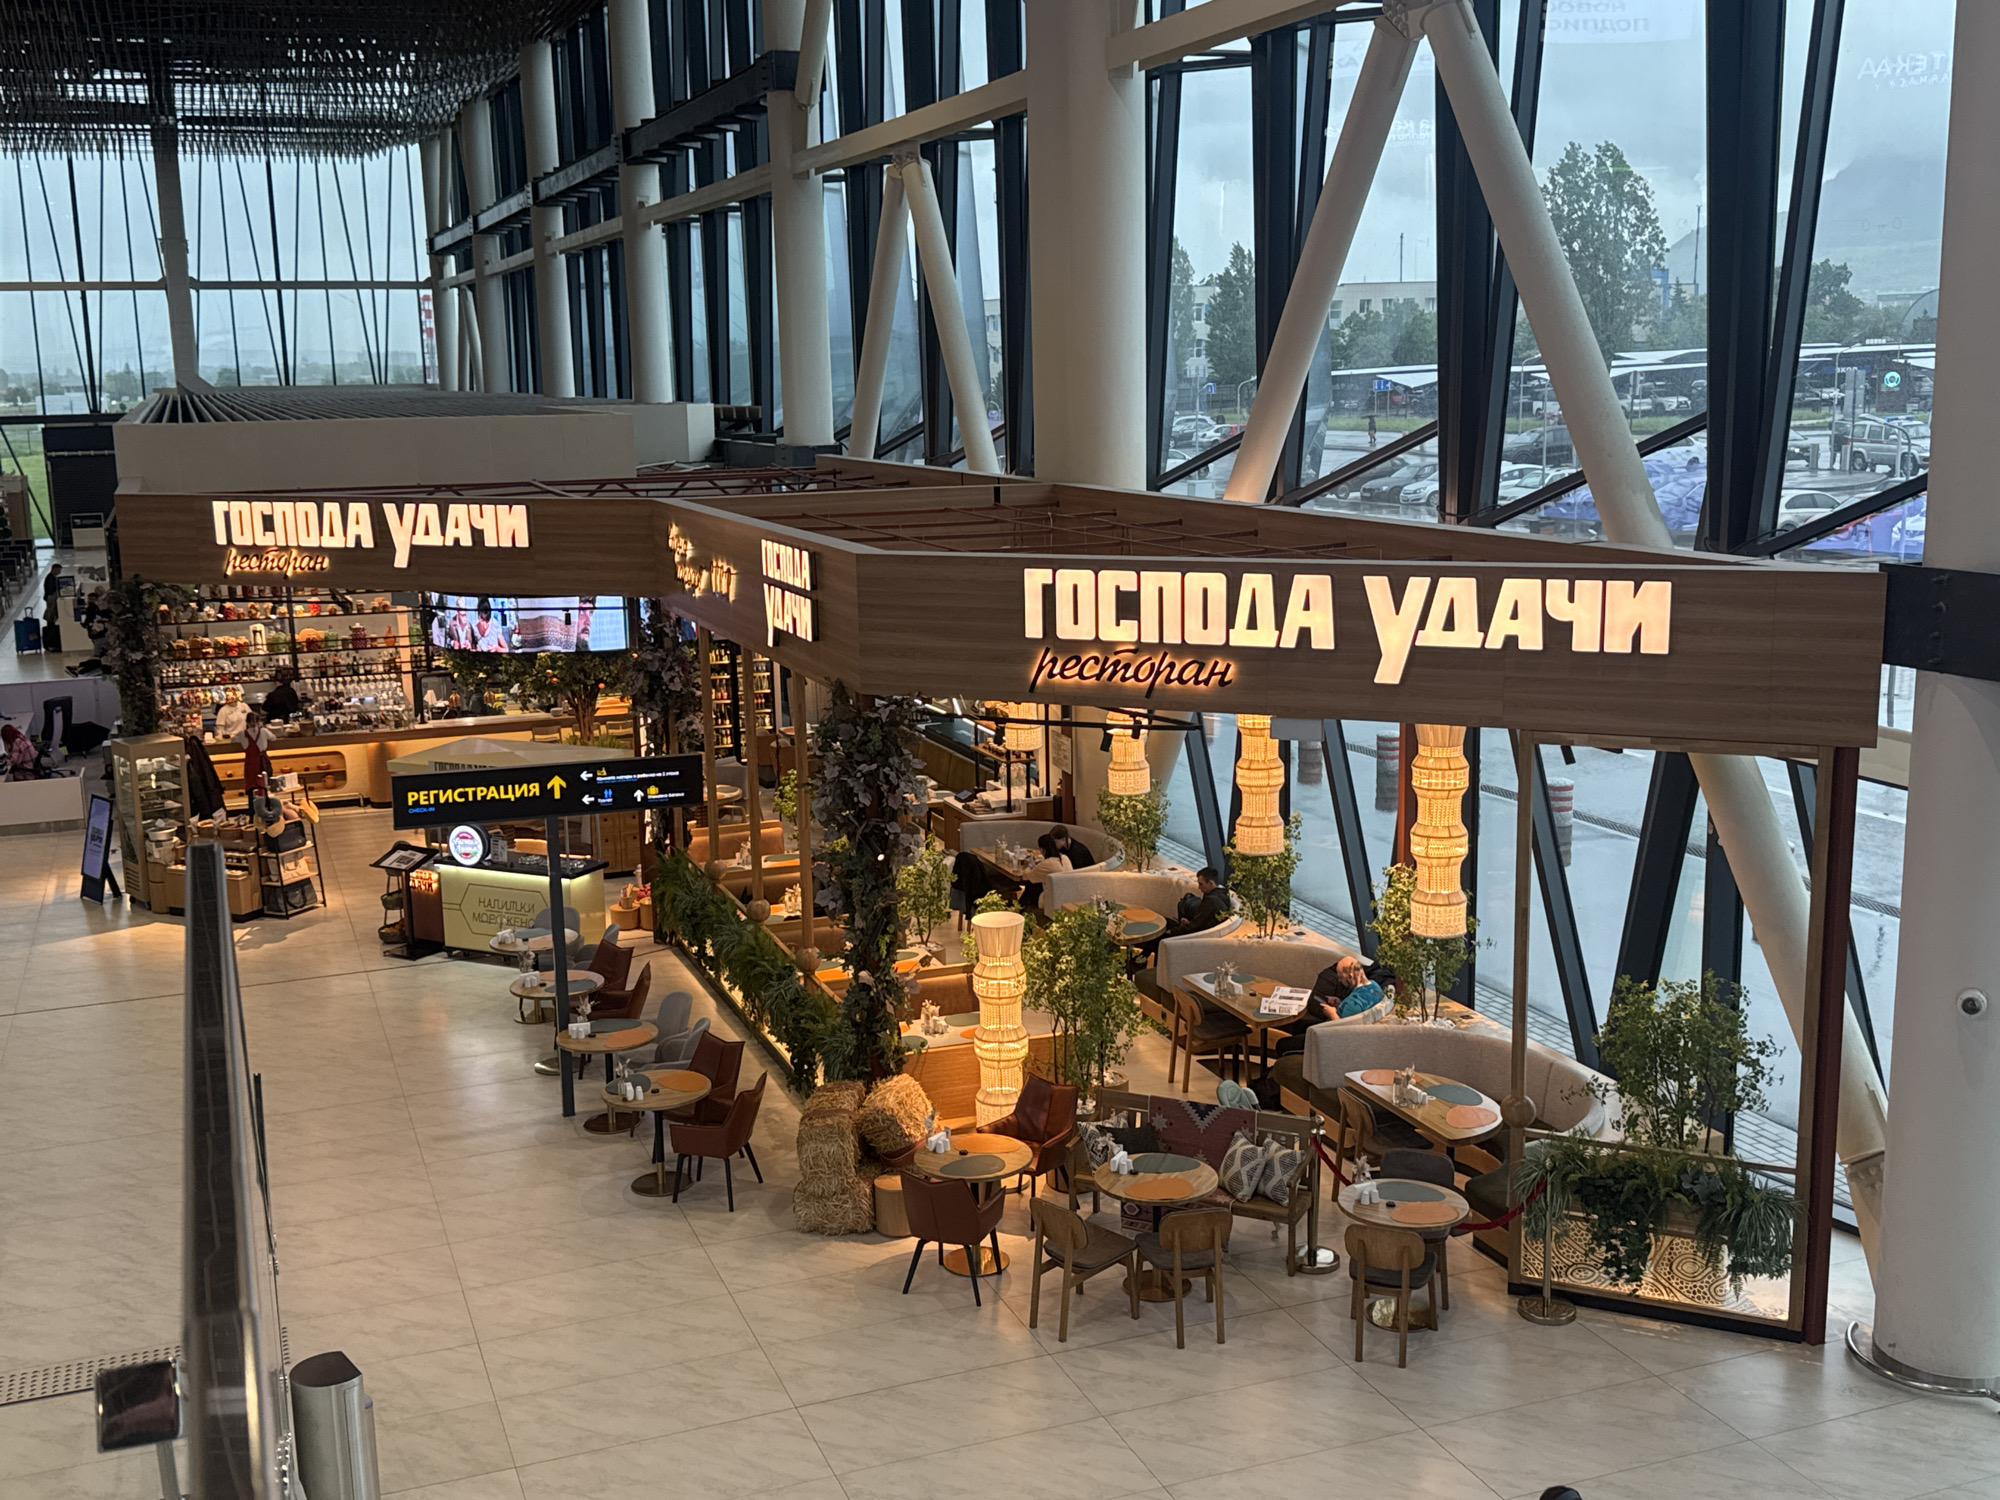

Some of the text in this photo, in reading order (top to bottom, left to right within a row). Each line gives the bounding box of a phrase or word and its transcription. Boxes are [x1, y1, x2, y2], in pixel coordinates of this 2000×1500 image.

[212, 501, 529, 568] ГОСПОДА УДАЧИ
[224, 547, 329, 579] ресторан
[761, 538, 812, 591] ГОСПОДА
[763, 582, 814, 648] УДАЧИ
[1023, 567, 1672, 685] ГОСПОДА УДАЧИ
[1028, 645, 1234, 698] ресторан
[407, 782, 540, 806] РЕГИСТРАЦИЯ
[472, 912, 535, 928] МОРОЖЕНО
